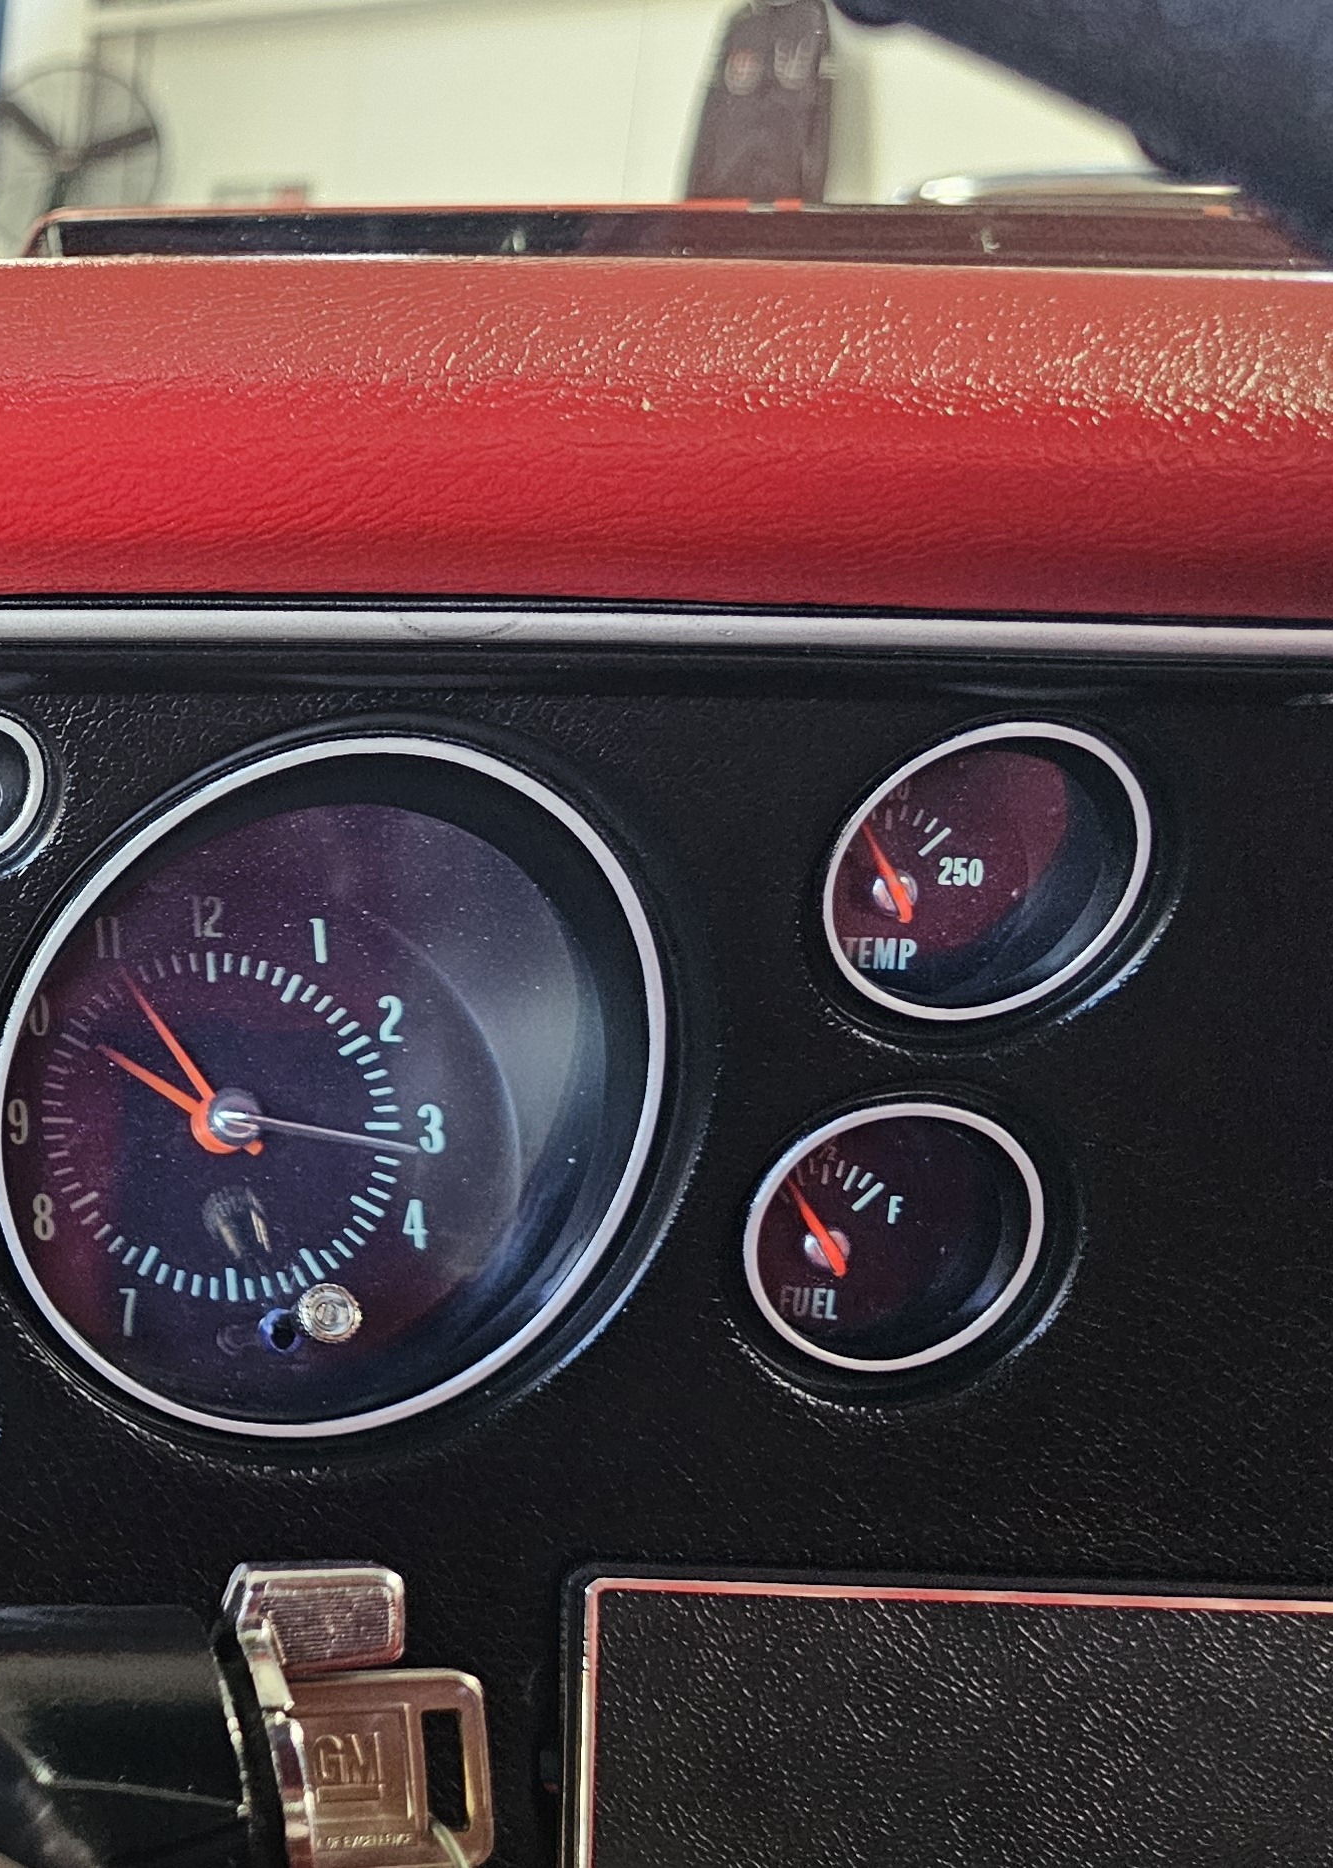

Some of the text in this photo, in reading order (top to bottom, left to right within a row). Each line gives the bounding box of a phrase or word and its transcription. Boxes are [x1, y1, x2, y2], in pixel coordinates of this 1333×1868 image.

[937, 857, 984, 887] 250
[95, 917, 120, 959] 11
[192, 896, 223, 938] 12
[309, 918, 328, 963] 1
[842, 936, 918, 971] TEMP
[378, 995, 404, 1043] 2
[7, 1098, 29, 1144] 9
[416, 1103, 445, 1154] 3
[32, 1194, 55, 1241] 8
[402, 1199, 427, 1250] 4
[887, 1195, 904, 1225] F
[118, 1287, 136, 1337] 7
[780, 1285, 838, 1321] FUEL
[314, 1731, 384, 1784] GM
